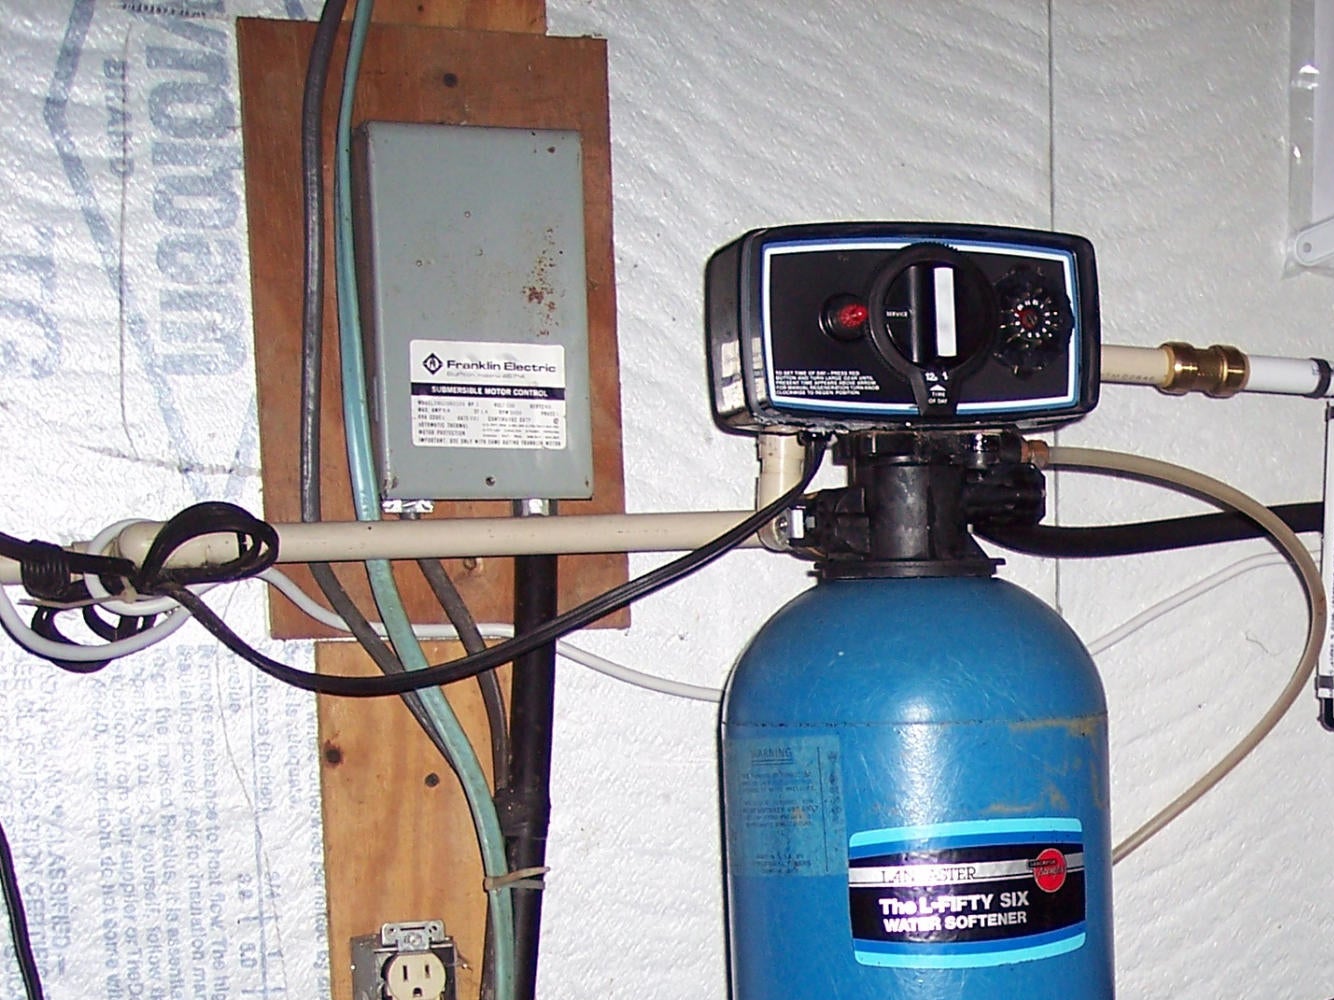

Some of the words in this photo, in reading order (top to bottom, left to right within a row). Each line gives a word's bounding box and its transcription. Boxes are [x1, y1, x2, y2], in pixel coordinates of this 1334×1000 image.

[447, 360, 500, 370] Franklin
[504, 362, 556, 372] Electric
[431, 386, 482, 395] SUBMERSIBLE
[513, 389, 548, 397] CONTROL
[879, 898, 918, 915] The
[1000, 891, 1029, 908] SIX
[188, 874, 207, 961] insulation
[883, 916, 942, 932] WATER
[945, 911, 1027, 930] SOFTENER
